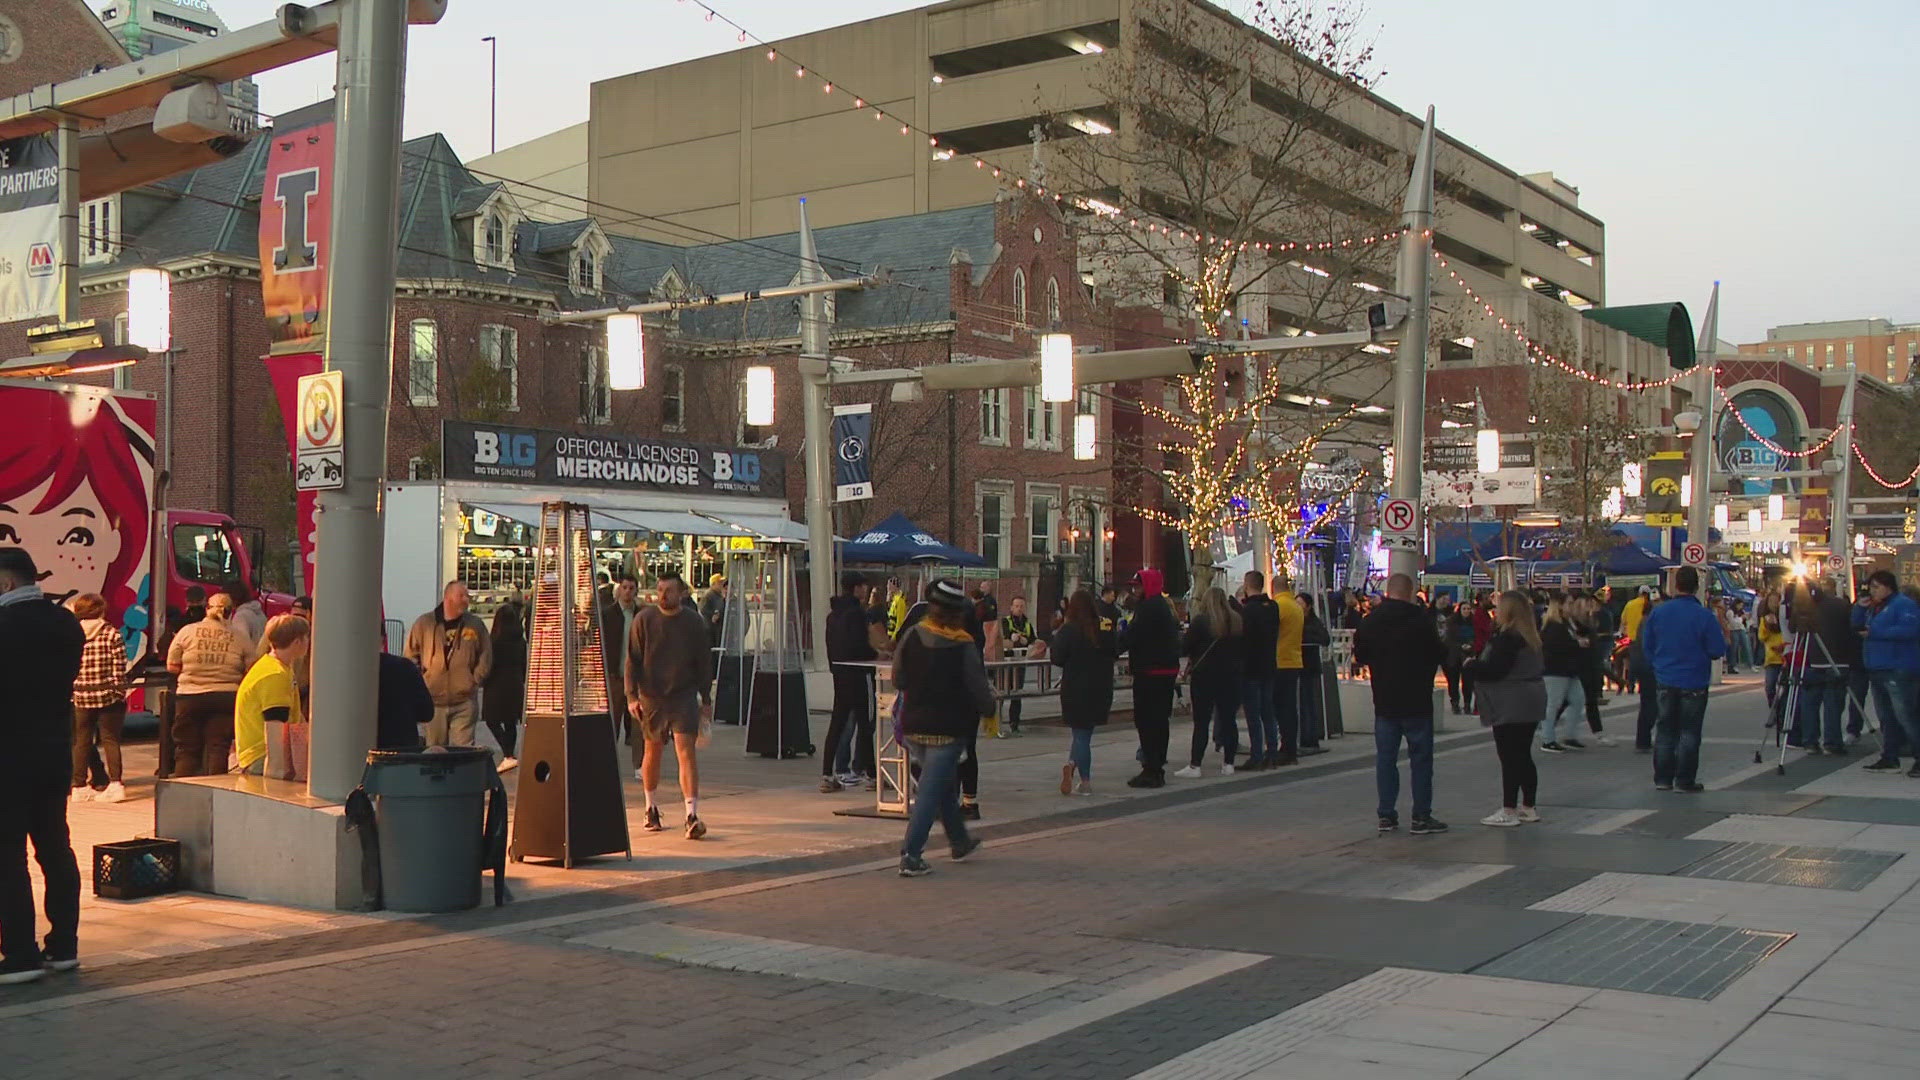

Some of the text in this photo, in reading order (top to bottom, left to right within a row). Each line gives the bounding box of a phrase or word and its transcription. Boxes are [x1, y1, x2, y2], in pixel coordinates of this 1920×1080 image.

[0, 166, 58, 196] PARTNERS
[556, 436, 699, 465] OFFICIAL LICENSED
[1500, 454, 1531, 464] PARTNERS
[474, 466, 536, 478] BIG TEN SINCE 1896
[556, 457, 699, 485] MERCHANDISE
[196, 627, 235, 642] ECLIPSE
[197, 640, 230, 652] EVENT
[196, 653, 227, 665] STAFF
